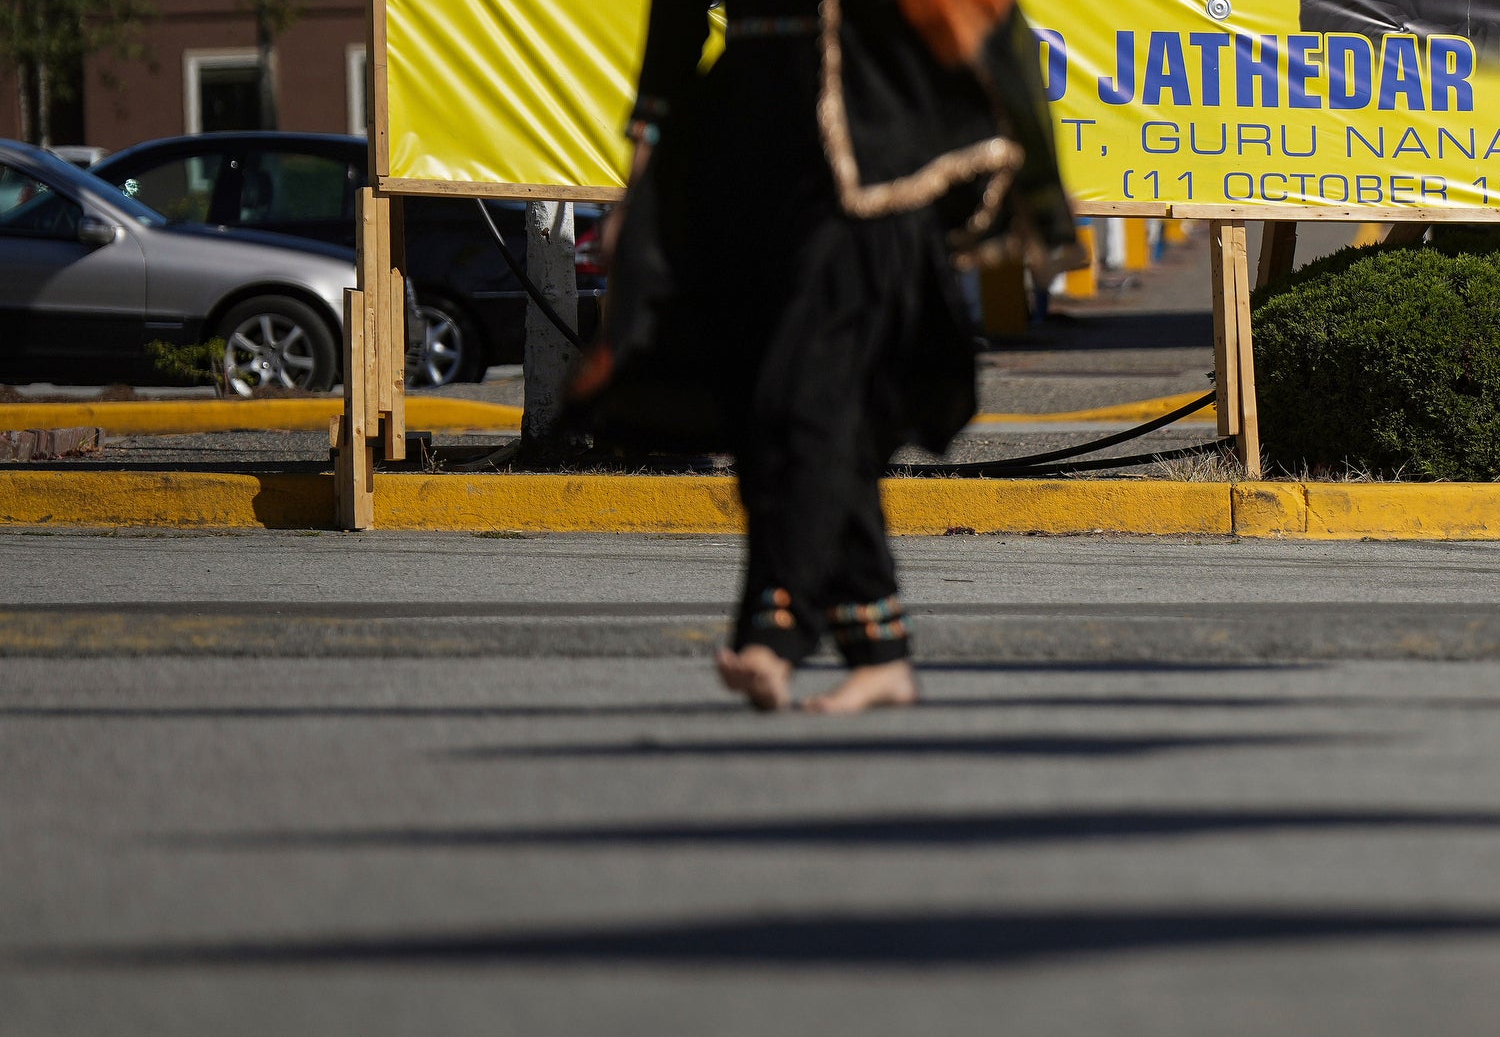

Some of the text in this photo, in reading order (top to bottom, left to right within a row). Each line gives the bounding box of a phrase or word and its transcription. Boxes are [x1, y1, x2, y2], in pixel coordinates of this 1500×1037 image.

[1098, 30, 1474, 111] JATHEDAR
[1141, 121, 1317, 157] GURU
[1123, 169, 1193, 200] (11
[1223, 172, 1448, 204] OCTOBER
